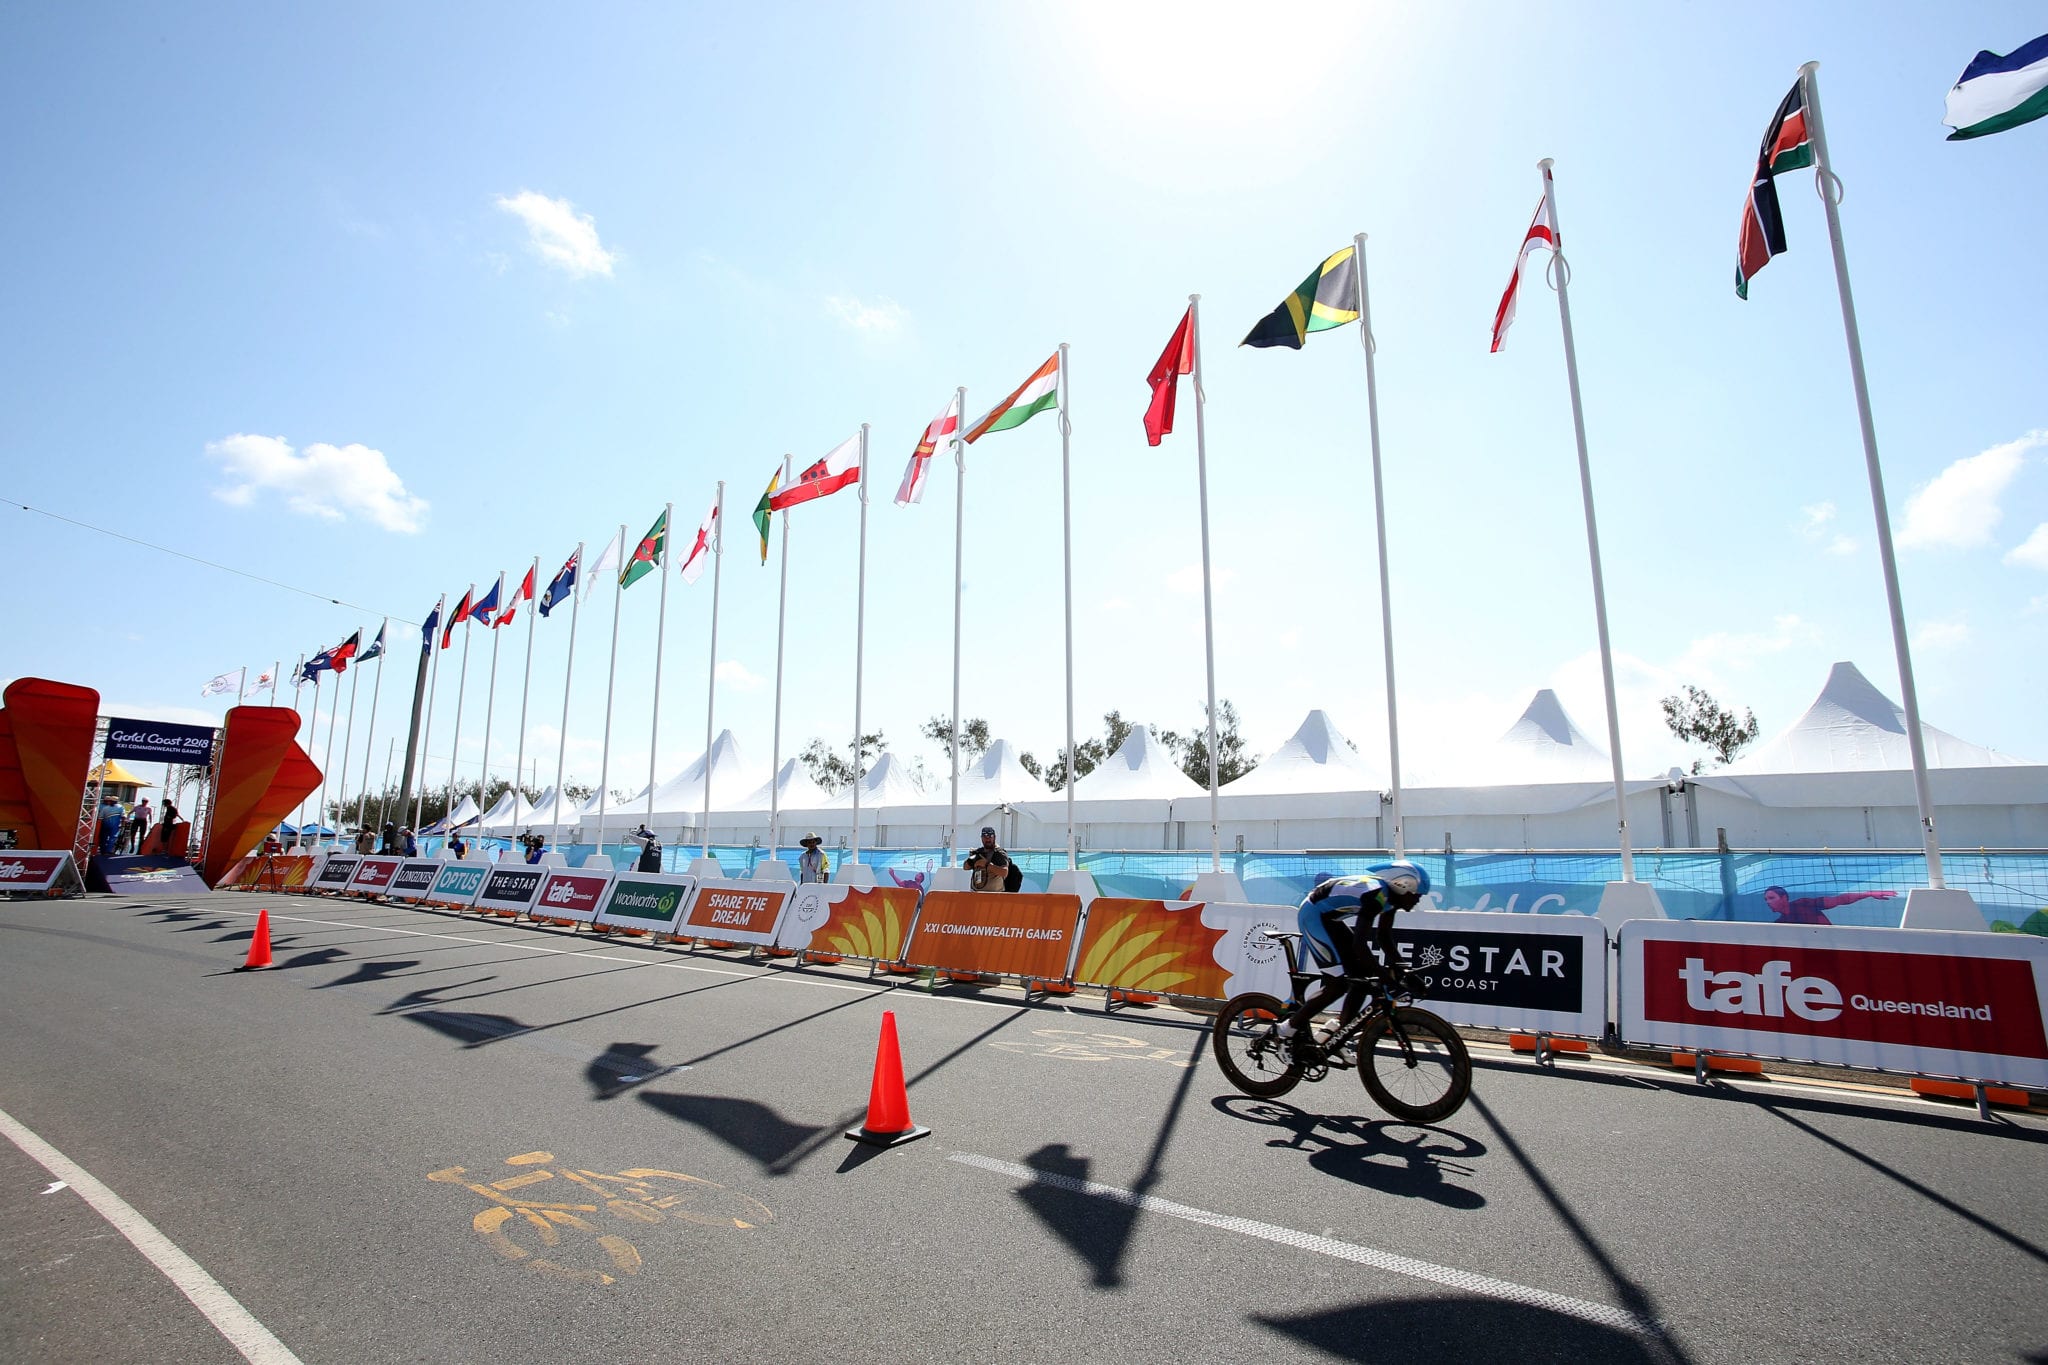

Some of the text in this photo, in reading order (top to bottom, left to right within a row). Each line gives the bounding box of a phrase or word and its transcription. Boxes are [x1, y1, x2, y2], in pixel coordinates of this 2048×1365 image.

[111, 730, 209, 748] Gold Coast 2018
[128, 744, 181, 753] COMMONWEALTH
[399, 870, 434, 884] LONGINES
[439, 871, 482, 891] OPTUS
[490, 876, 537, 890] THE STAR
[546, 881, 575, 903] tafe
[615, 891, 660, 909] Woolworths
[708, 893, 769, 911] SHARE THE
[711, 909, 752, 926] DREAM
[923, 922, 1063, 941] XXI COMMONWEALTH GAMES
[1243, 922, 1279, 949] COMMONWEALTH
[1245, 952, 1277, 965] FEDERATION
[1366, 940, 1566, 978] HE STAR
[1440, 977, 1499, 991] COAST
[1678, 957, 1993, 1023] tafe Queensland
